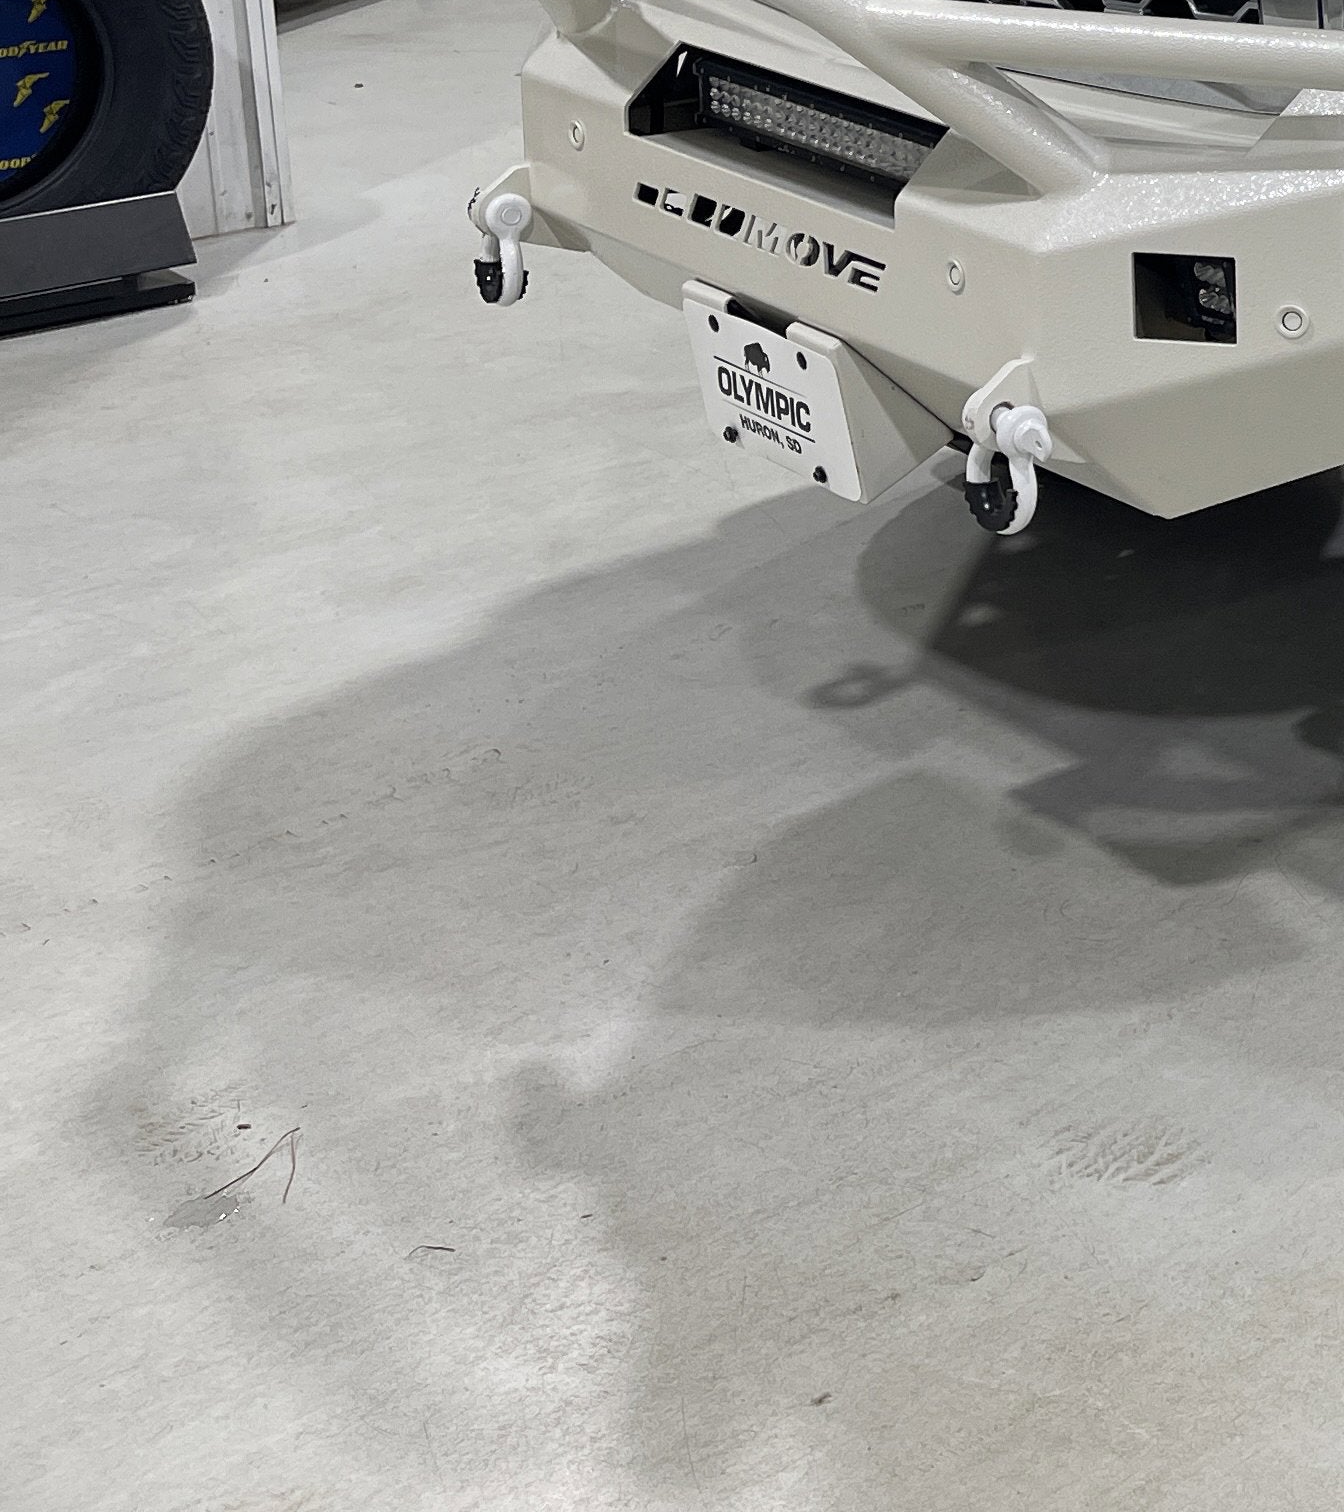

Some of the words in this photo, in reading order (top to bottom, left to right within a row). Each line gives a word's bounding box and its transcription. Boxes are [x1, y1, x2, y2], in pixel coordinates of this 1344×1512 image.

[718, 366, 811, 432] OLYMPIC
[740, 413, 785, 449] HURON,
[786, 435, 802, 454] SD
